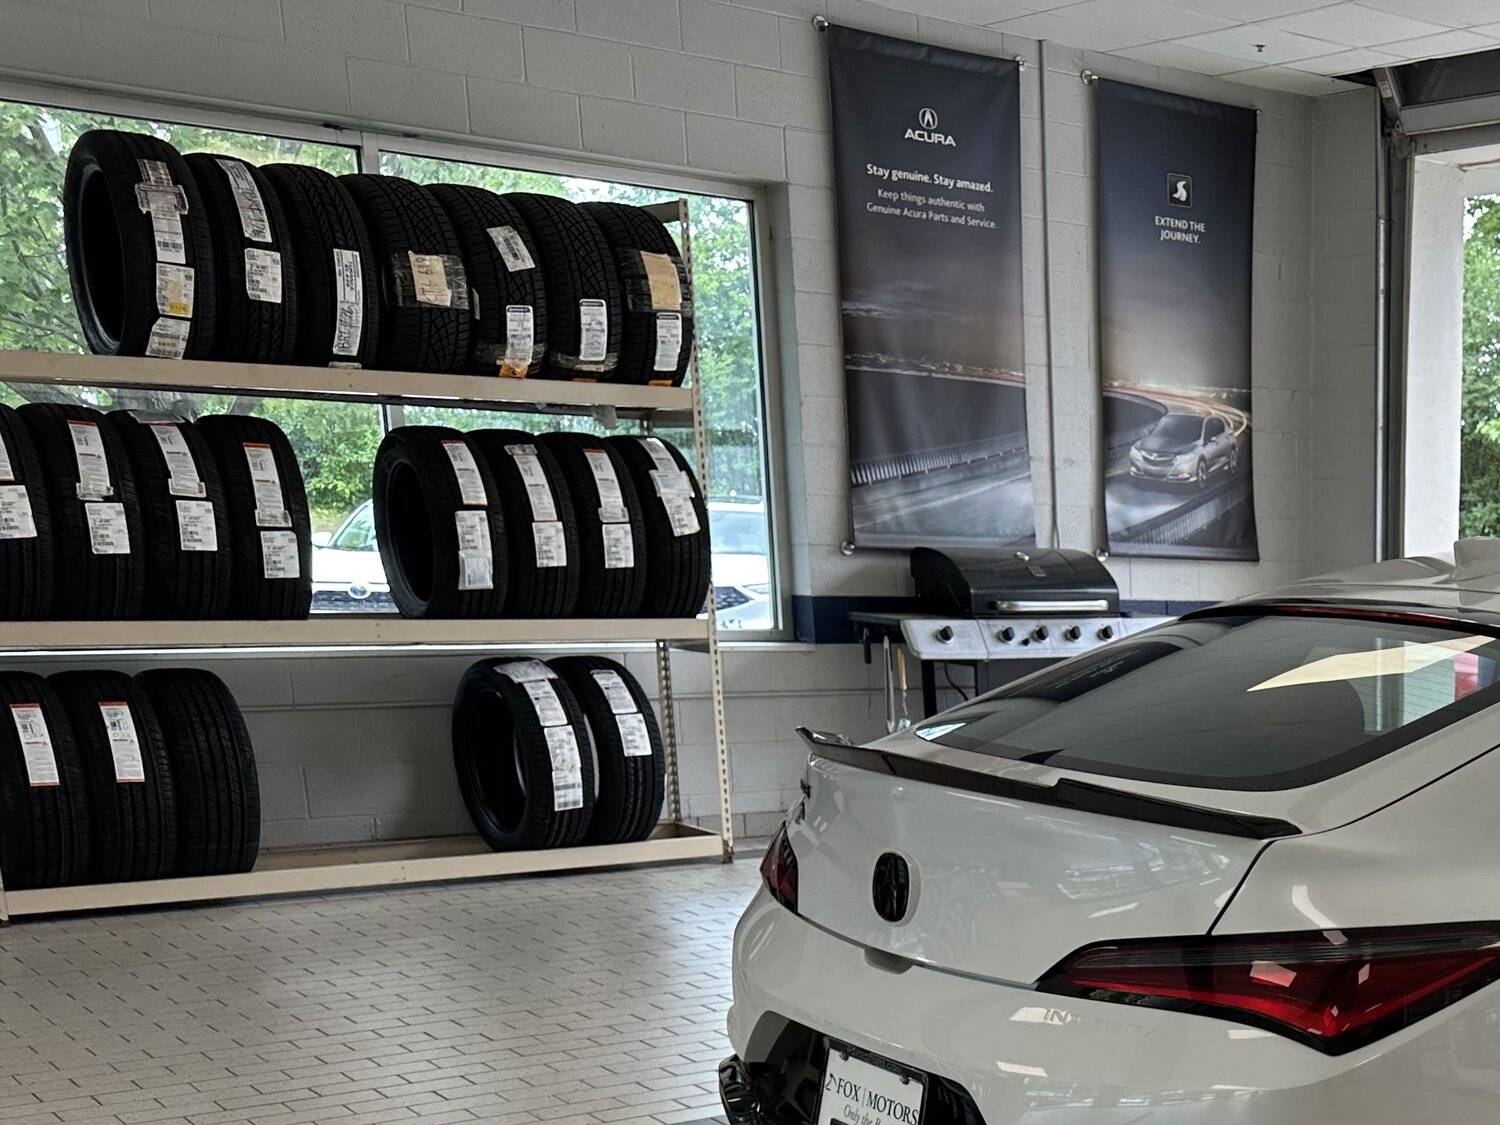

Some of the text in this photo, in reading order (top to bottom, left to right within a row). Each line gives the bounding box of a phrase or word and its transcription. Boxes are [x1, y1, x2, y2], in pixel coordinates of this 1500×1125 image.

[904, 128, 956, 147] ACURA
[866, 163, 994, 193] Stay genuine. Stay amazed.
[878, 188, 985, 212] Keep things authentic with
[866, 202, 901, 216] Genuine
[902, 207, 927, 219] Acura
[928, 210, 948, 223] Parts
[950, 214, 966, 225] and
[1155, 215, 1206, 233] EXTEND THE
[837, 1077, 861, 1103] FOX
[843, 1104, 860, 1125] Only
